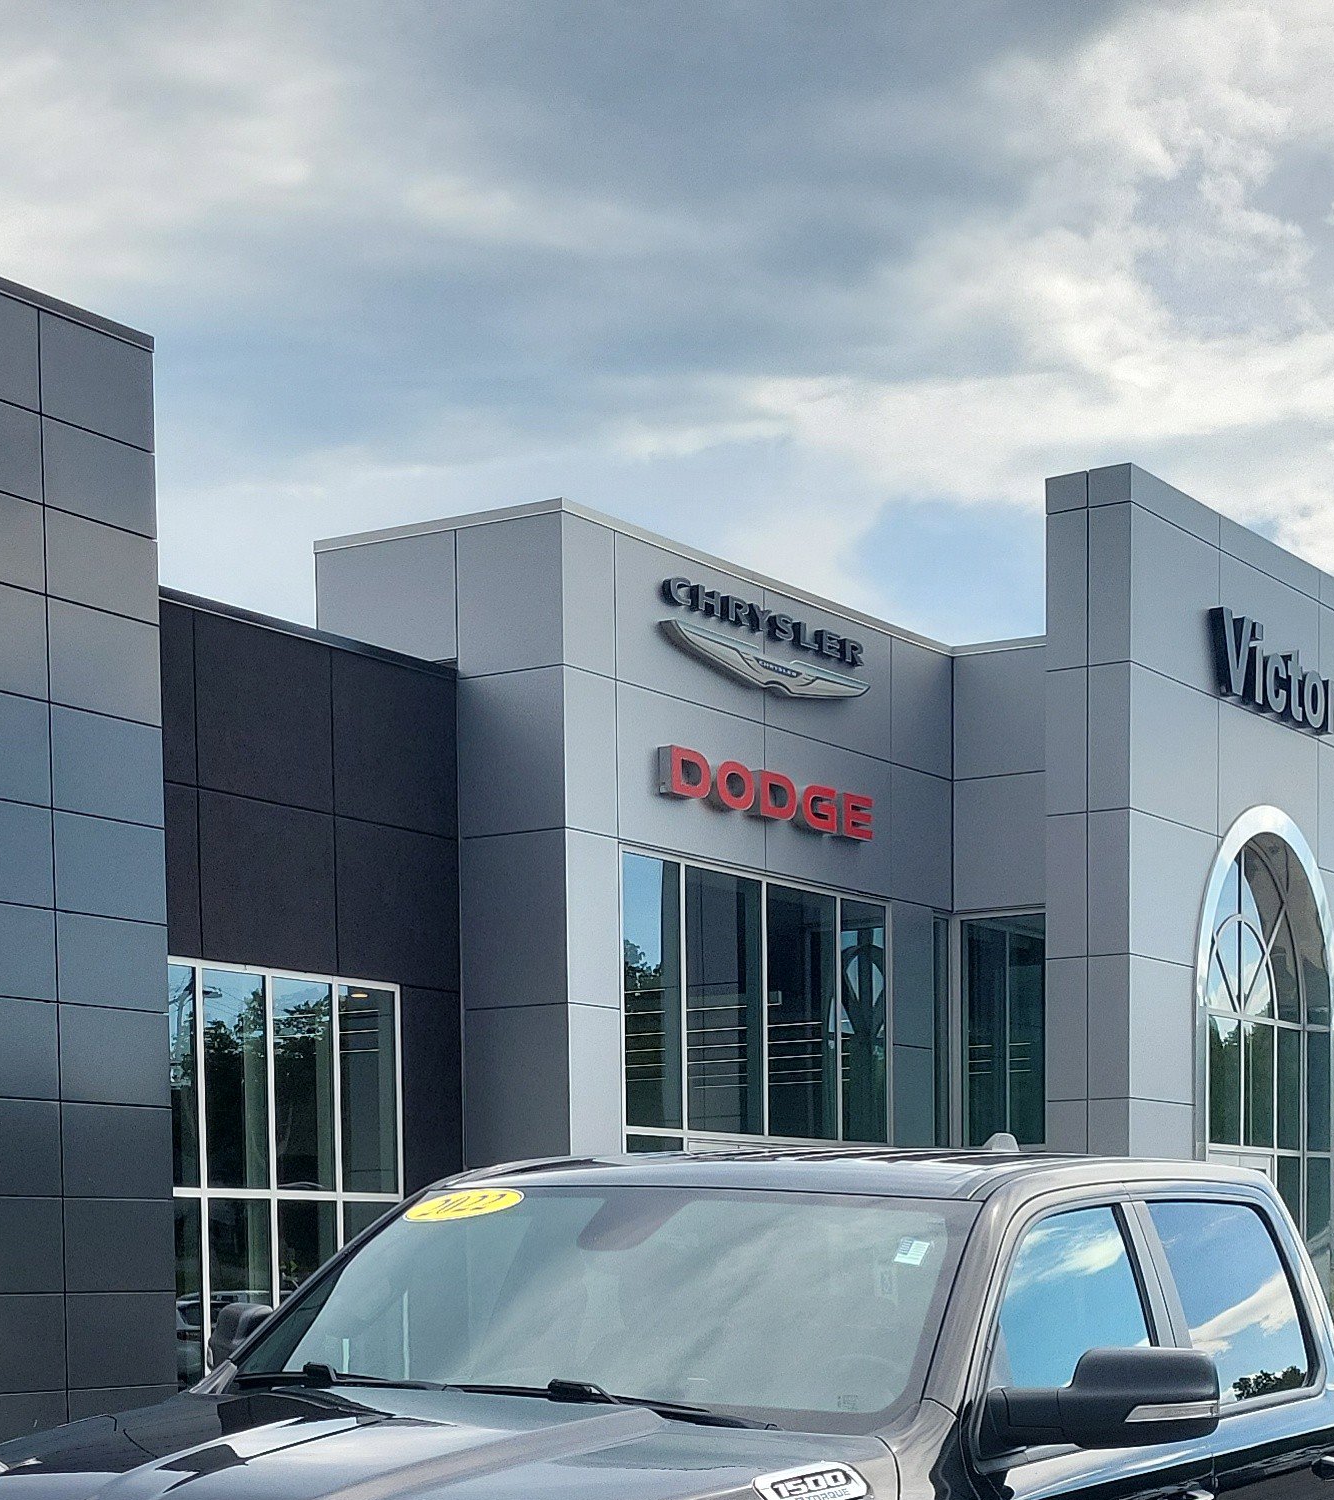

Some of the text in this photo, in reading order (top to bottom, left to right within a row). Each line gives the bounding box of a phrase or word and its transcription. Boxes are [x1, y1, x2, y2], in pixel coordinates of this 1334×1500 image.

[665, 577, 864, 666] CHRYSLER
[670, 744, 874, 841] DODGE
[417, 1193, 508, 1218] 2022
[772, 1470, 848, 1498] 1500
